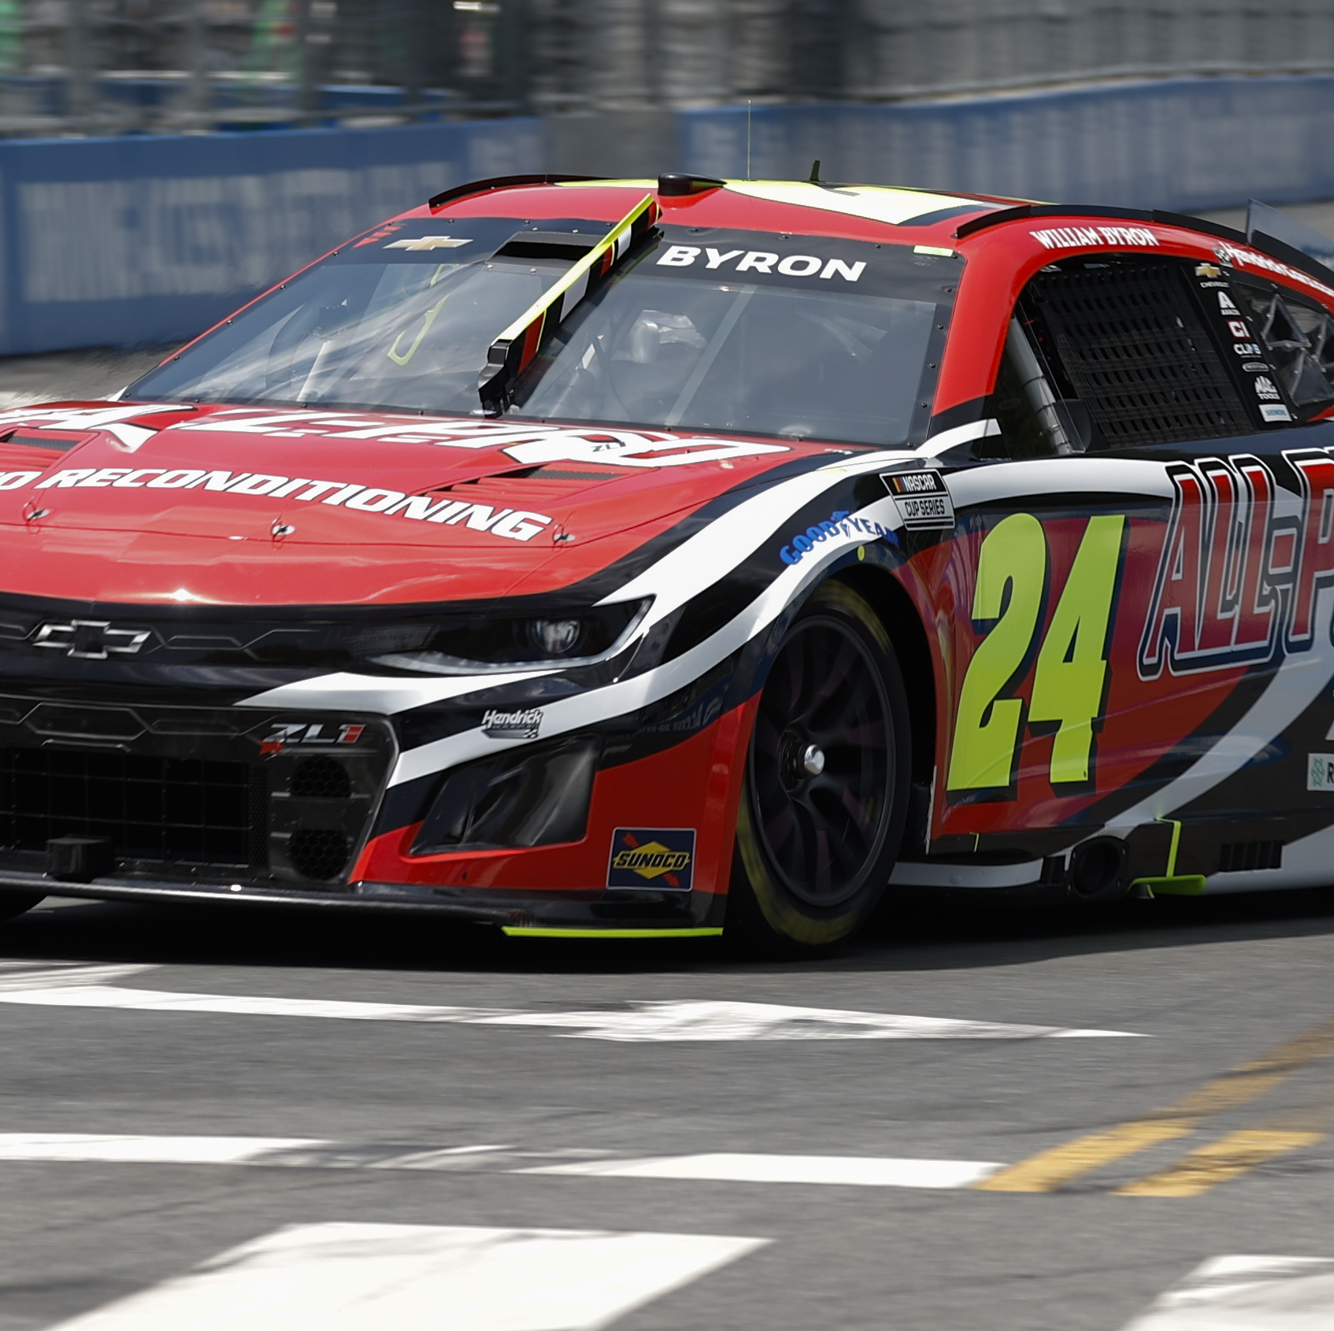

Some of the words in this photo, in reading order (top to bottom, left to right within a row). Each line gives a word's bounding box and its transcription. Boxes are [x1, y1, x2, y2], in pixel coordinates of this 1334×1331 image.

[1030, 225, 1104, 250] WILLIAM
[1097, 226, 1161, 247] BYRON
[656, 246, 867, 283] BYRON
[903, 473, 937, 492] NASCAR
[53, 466, 555, 543] RECONDITIONING
[904, 500, 920, 517] CUP
[919, 498, 945, 517] SERIES
[946, 512, 1127, 791] 24
[481, 708, 544, 729] Hendrick
[267, 722, 366, 745] ZL1
[613, 851, 689, 871] SUNOCO
